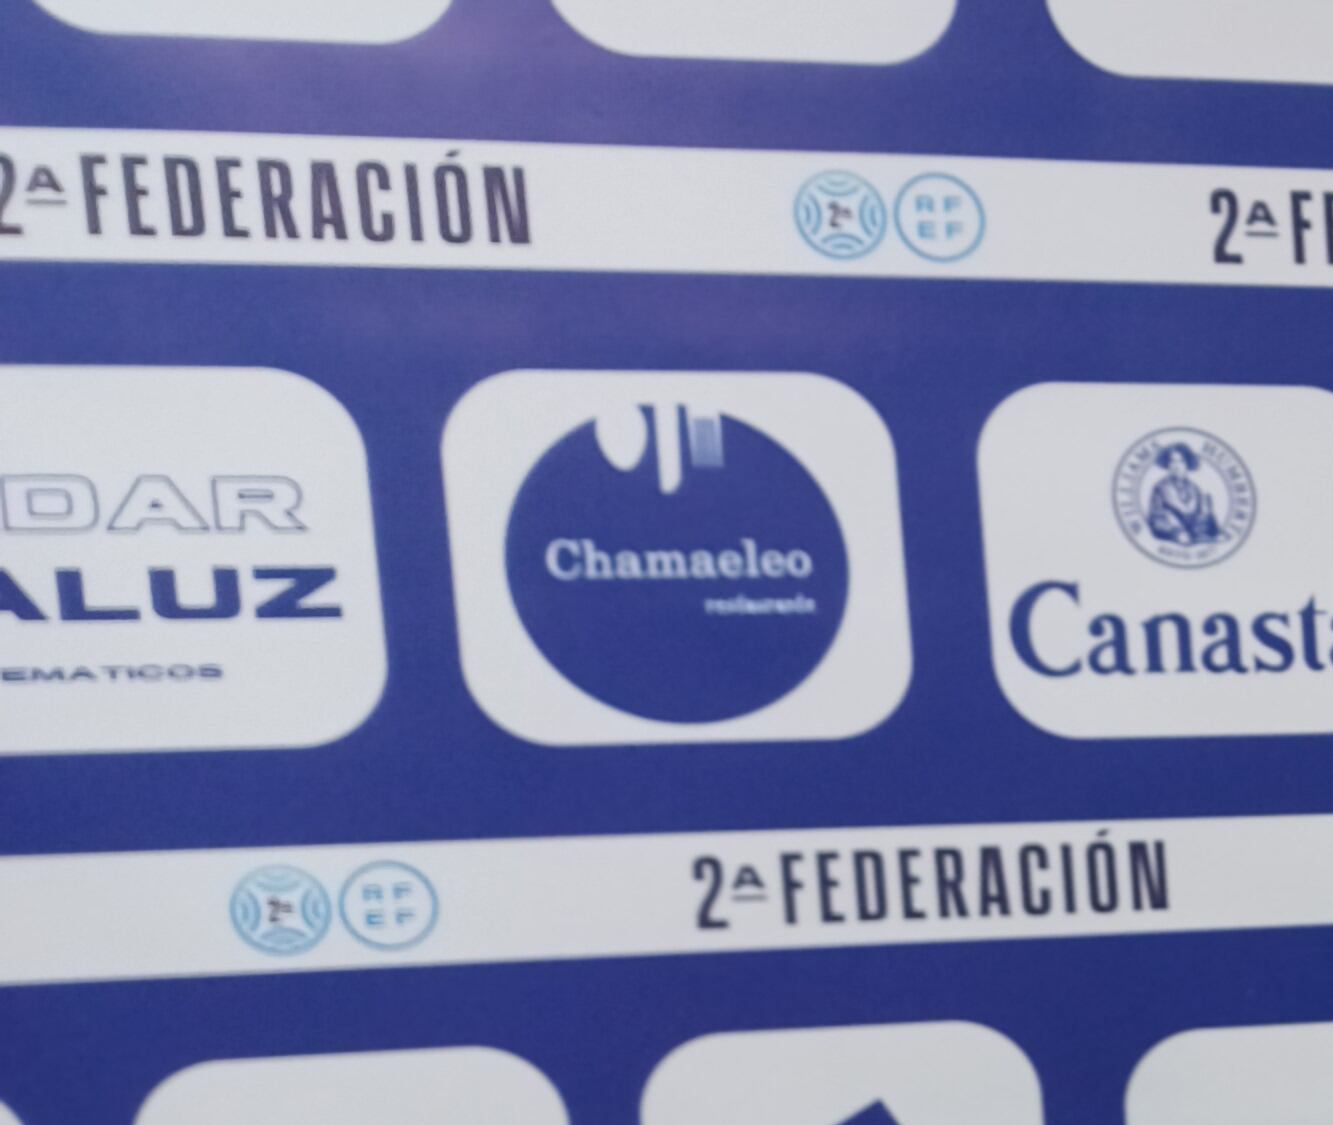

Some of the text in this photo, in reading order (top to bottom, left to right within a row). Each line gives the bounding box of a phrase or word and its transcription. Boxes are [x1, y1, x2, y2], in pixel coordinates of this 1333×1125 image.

[80, 151, 533, 245] FEDERACIÓN
[545, 537, 813, 580] Chamaeleo
[780, 830, 1170, 925] FEDERACIÓN
